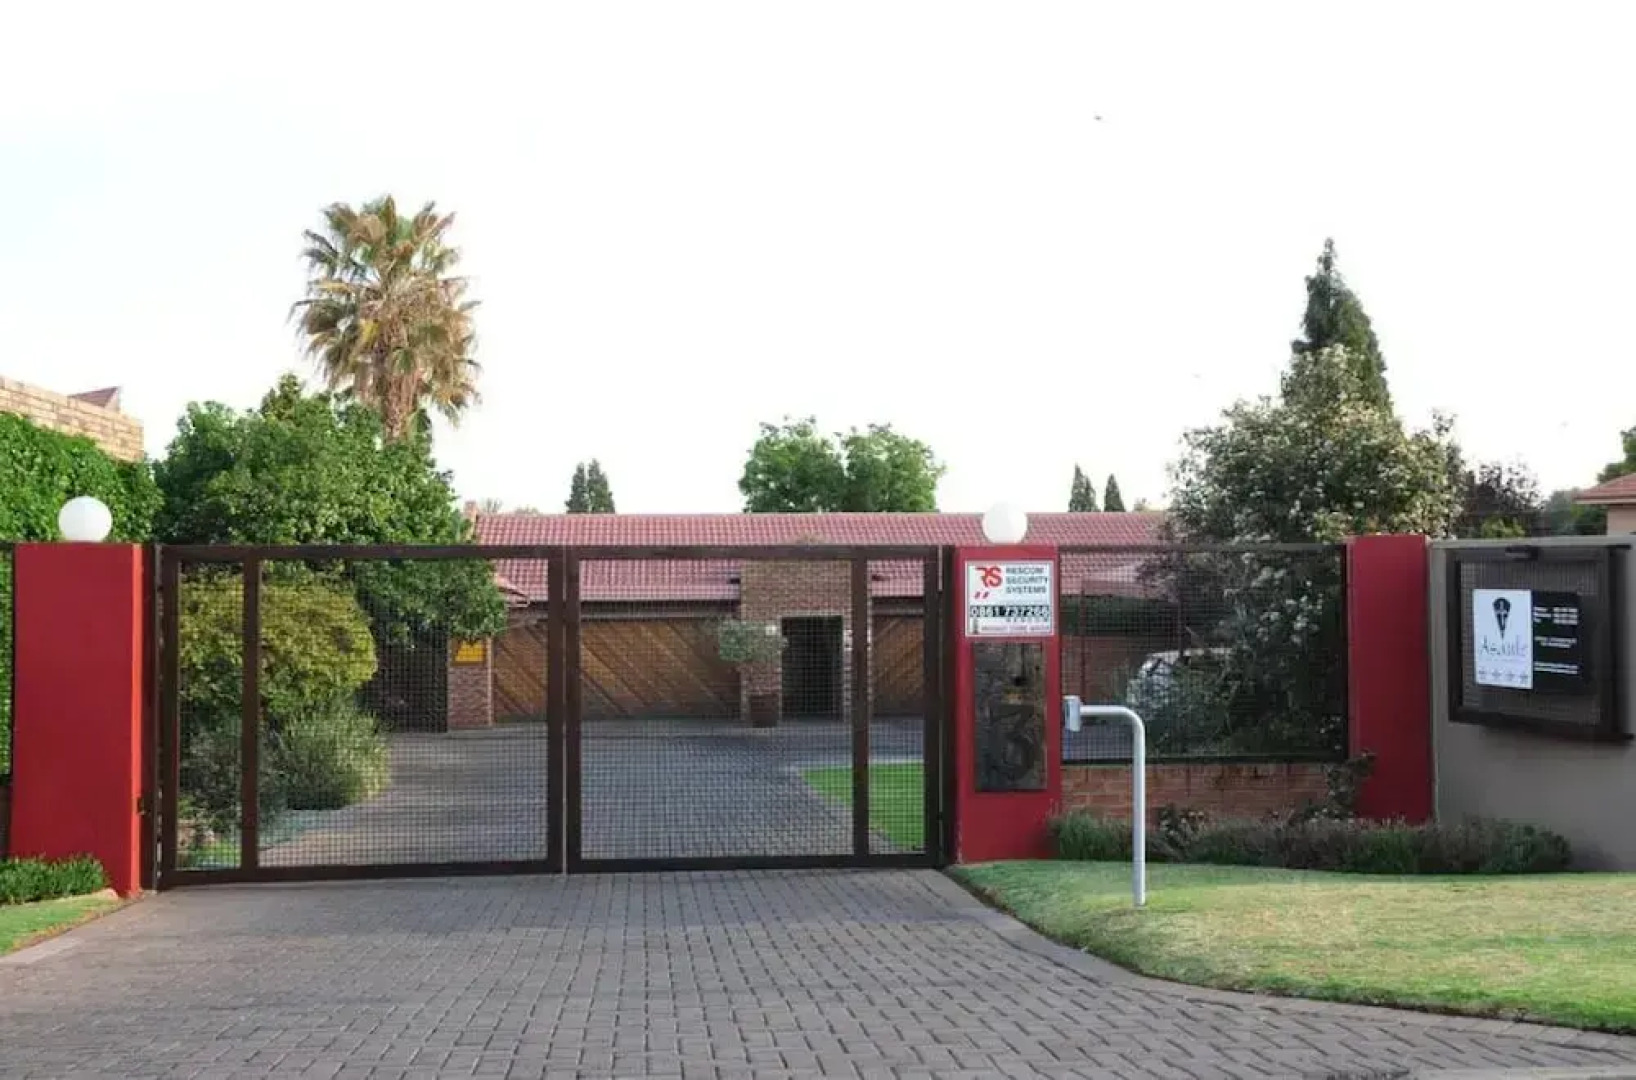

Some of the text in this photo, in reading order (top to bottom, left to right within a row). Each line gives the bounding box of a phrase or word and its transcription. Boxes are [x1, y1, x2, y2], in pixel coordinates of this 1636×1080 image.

[1006, 576, 1048, 584] SECURITY
[1006, 586, 1047, 594] SYSTEMS
[970, 605, 998, 618] 0861
